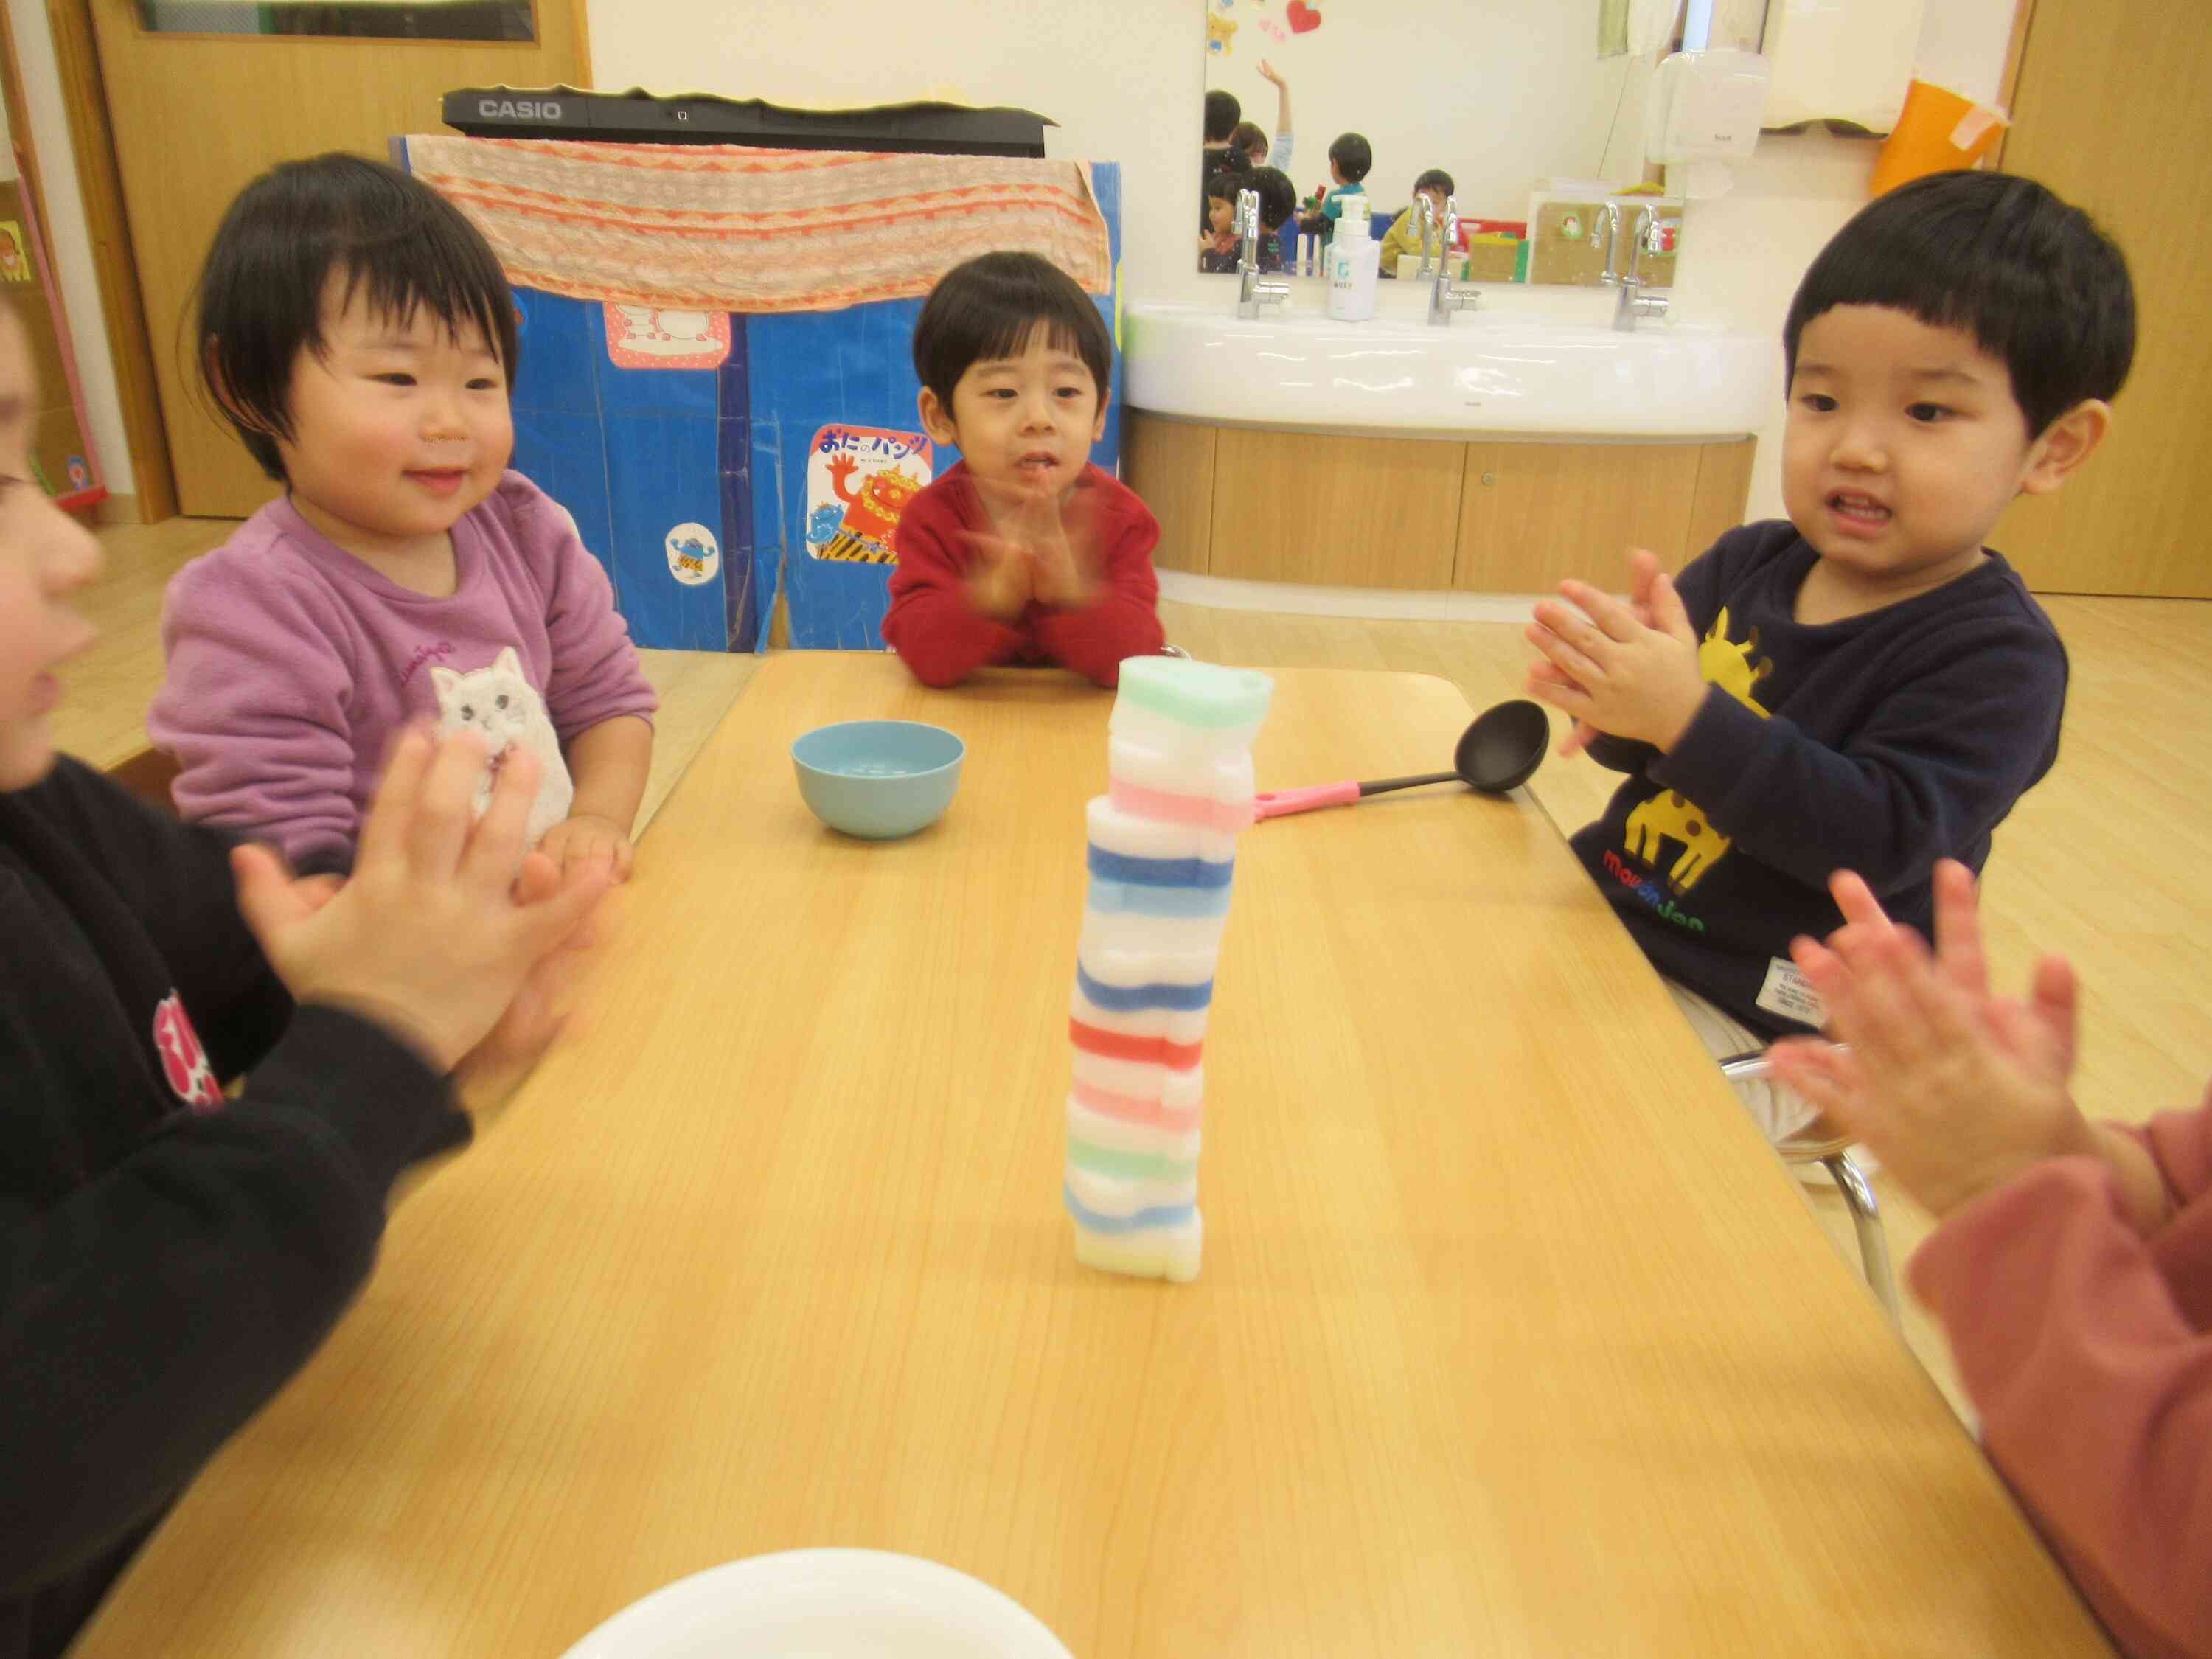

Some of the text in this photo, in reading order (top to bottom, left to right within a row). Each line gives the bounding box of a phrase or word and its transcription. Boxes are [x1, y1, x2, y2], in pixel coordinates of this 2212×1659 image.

[478, 100, 562, 119] CASIO
[818, 428, 928, 459] おにのパンツ
